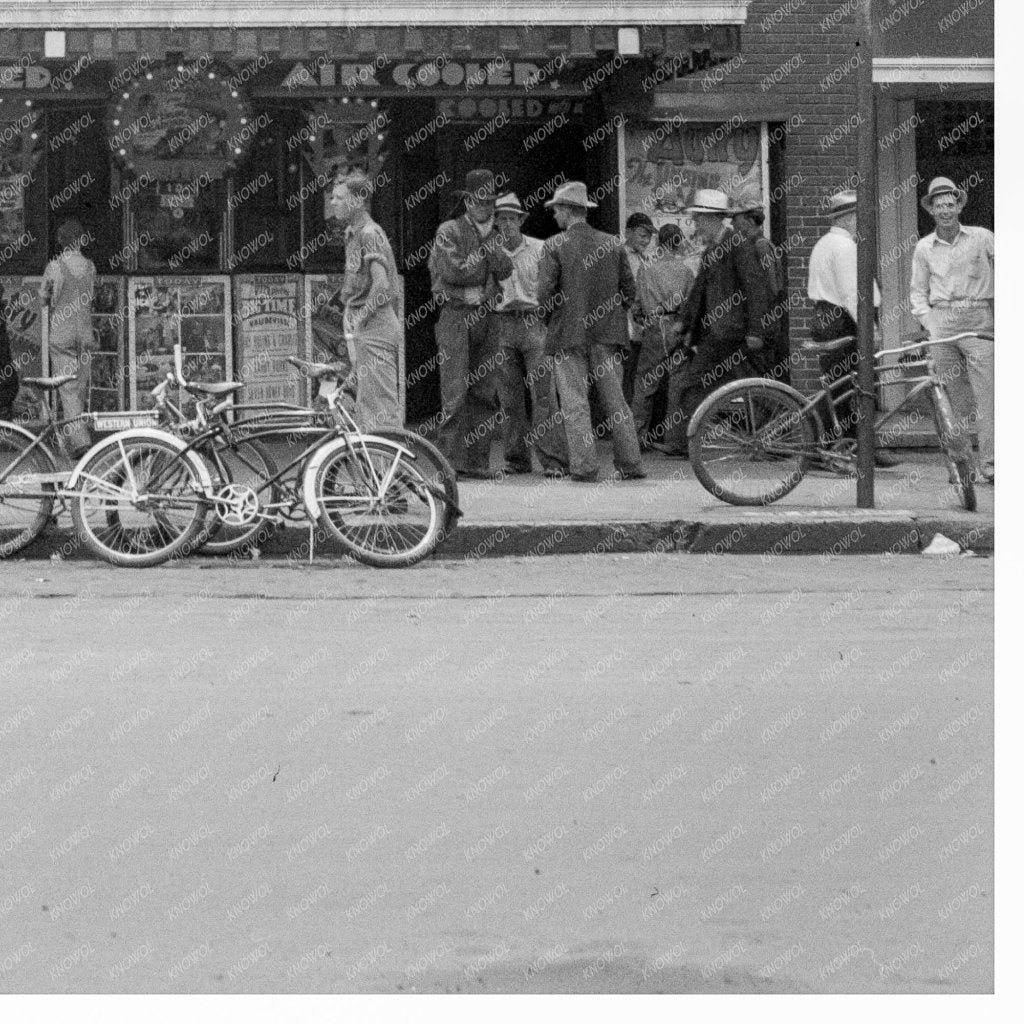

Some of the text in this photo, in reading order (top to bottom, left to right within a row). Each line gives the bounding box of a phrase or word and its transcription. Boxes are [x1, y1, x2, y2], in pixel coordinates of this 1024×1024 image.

[280, 61, 539, 86] AIR COOLED
[438, 98, 543, 118] COOLED
